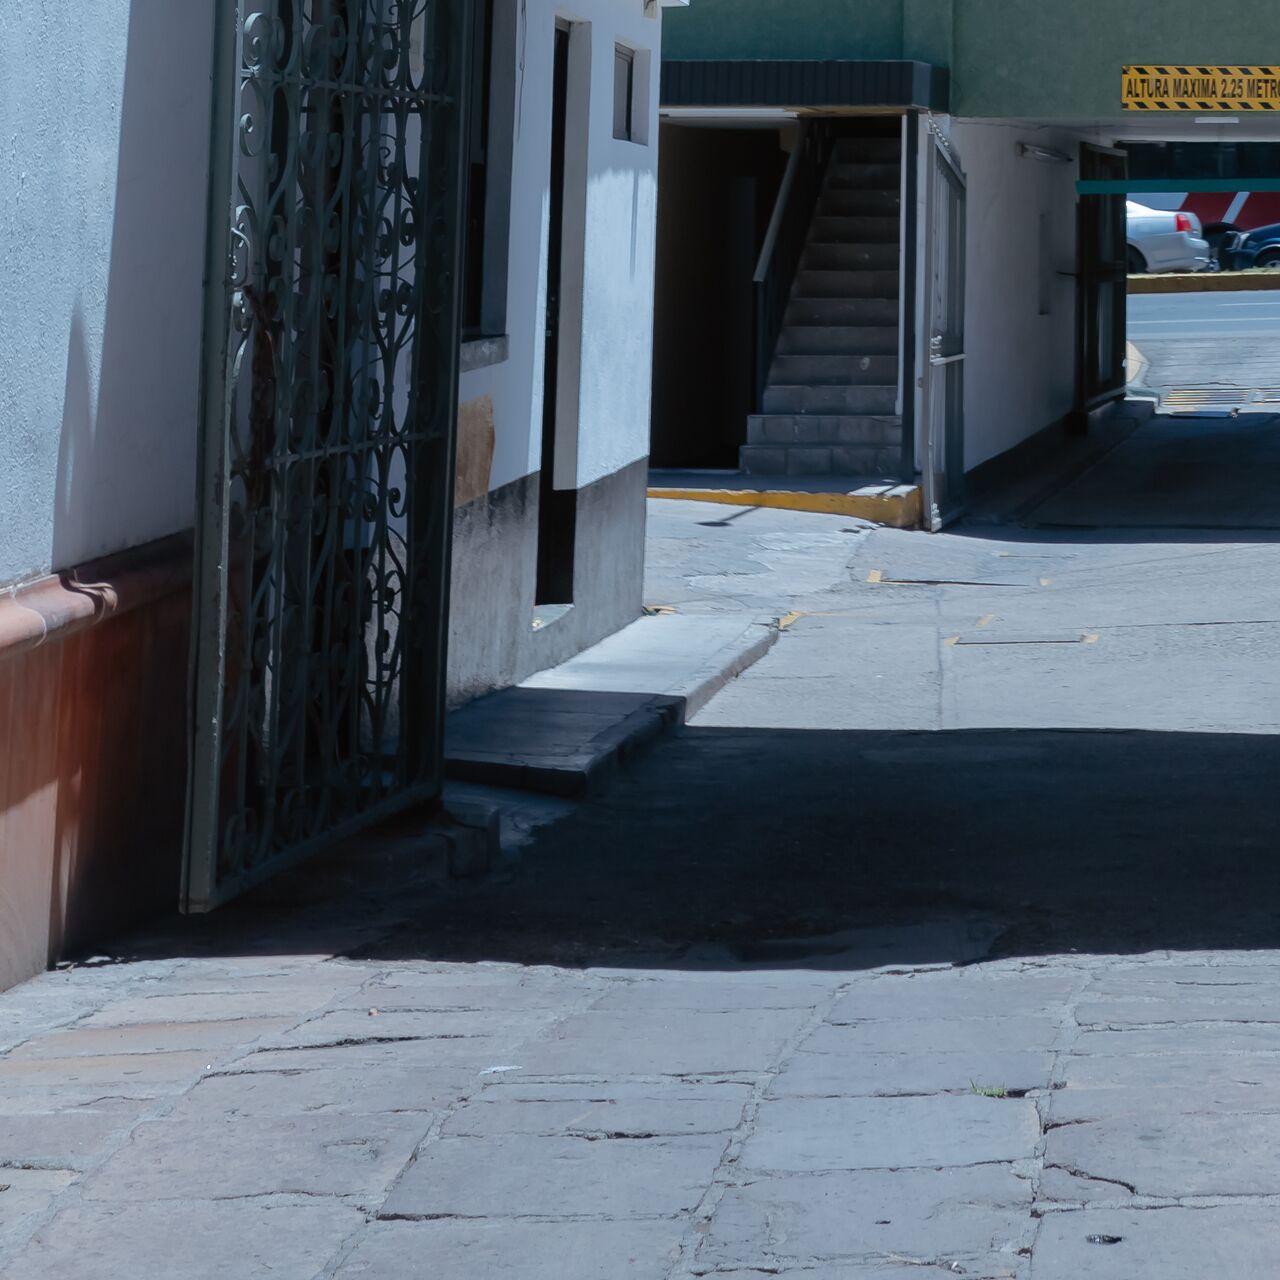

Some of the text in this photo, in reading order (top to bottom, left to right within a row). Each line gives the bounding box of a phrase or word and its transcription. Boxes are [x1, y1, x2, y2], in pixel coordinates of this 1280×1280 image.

[1126, 78, 1169, 98] ALTURA
[1172, 78, 1218, 98] MAXIMA
[1220, 78, 1244, 98] 2.25
